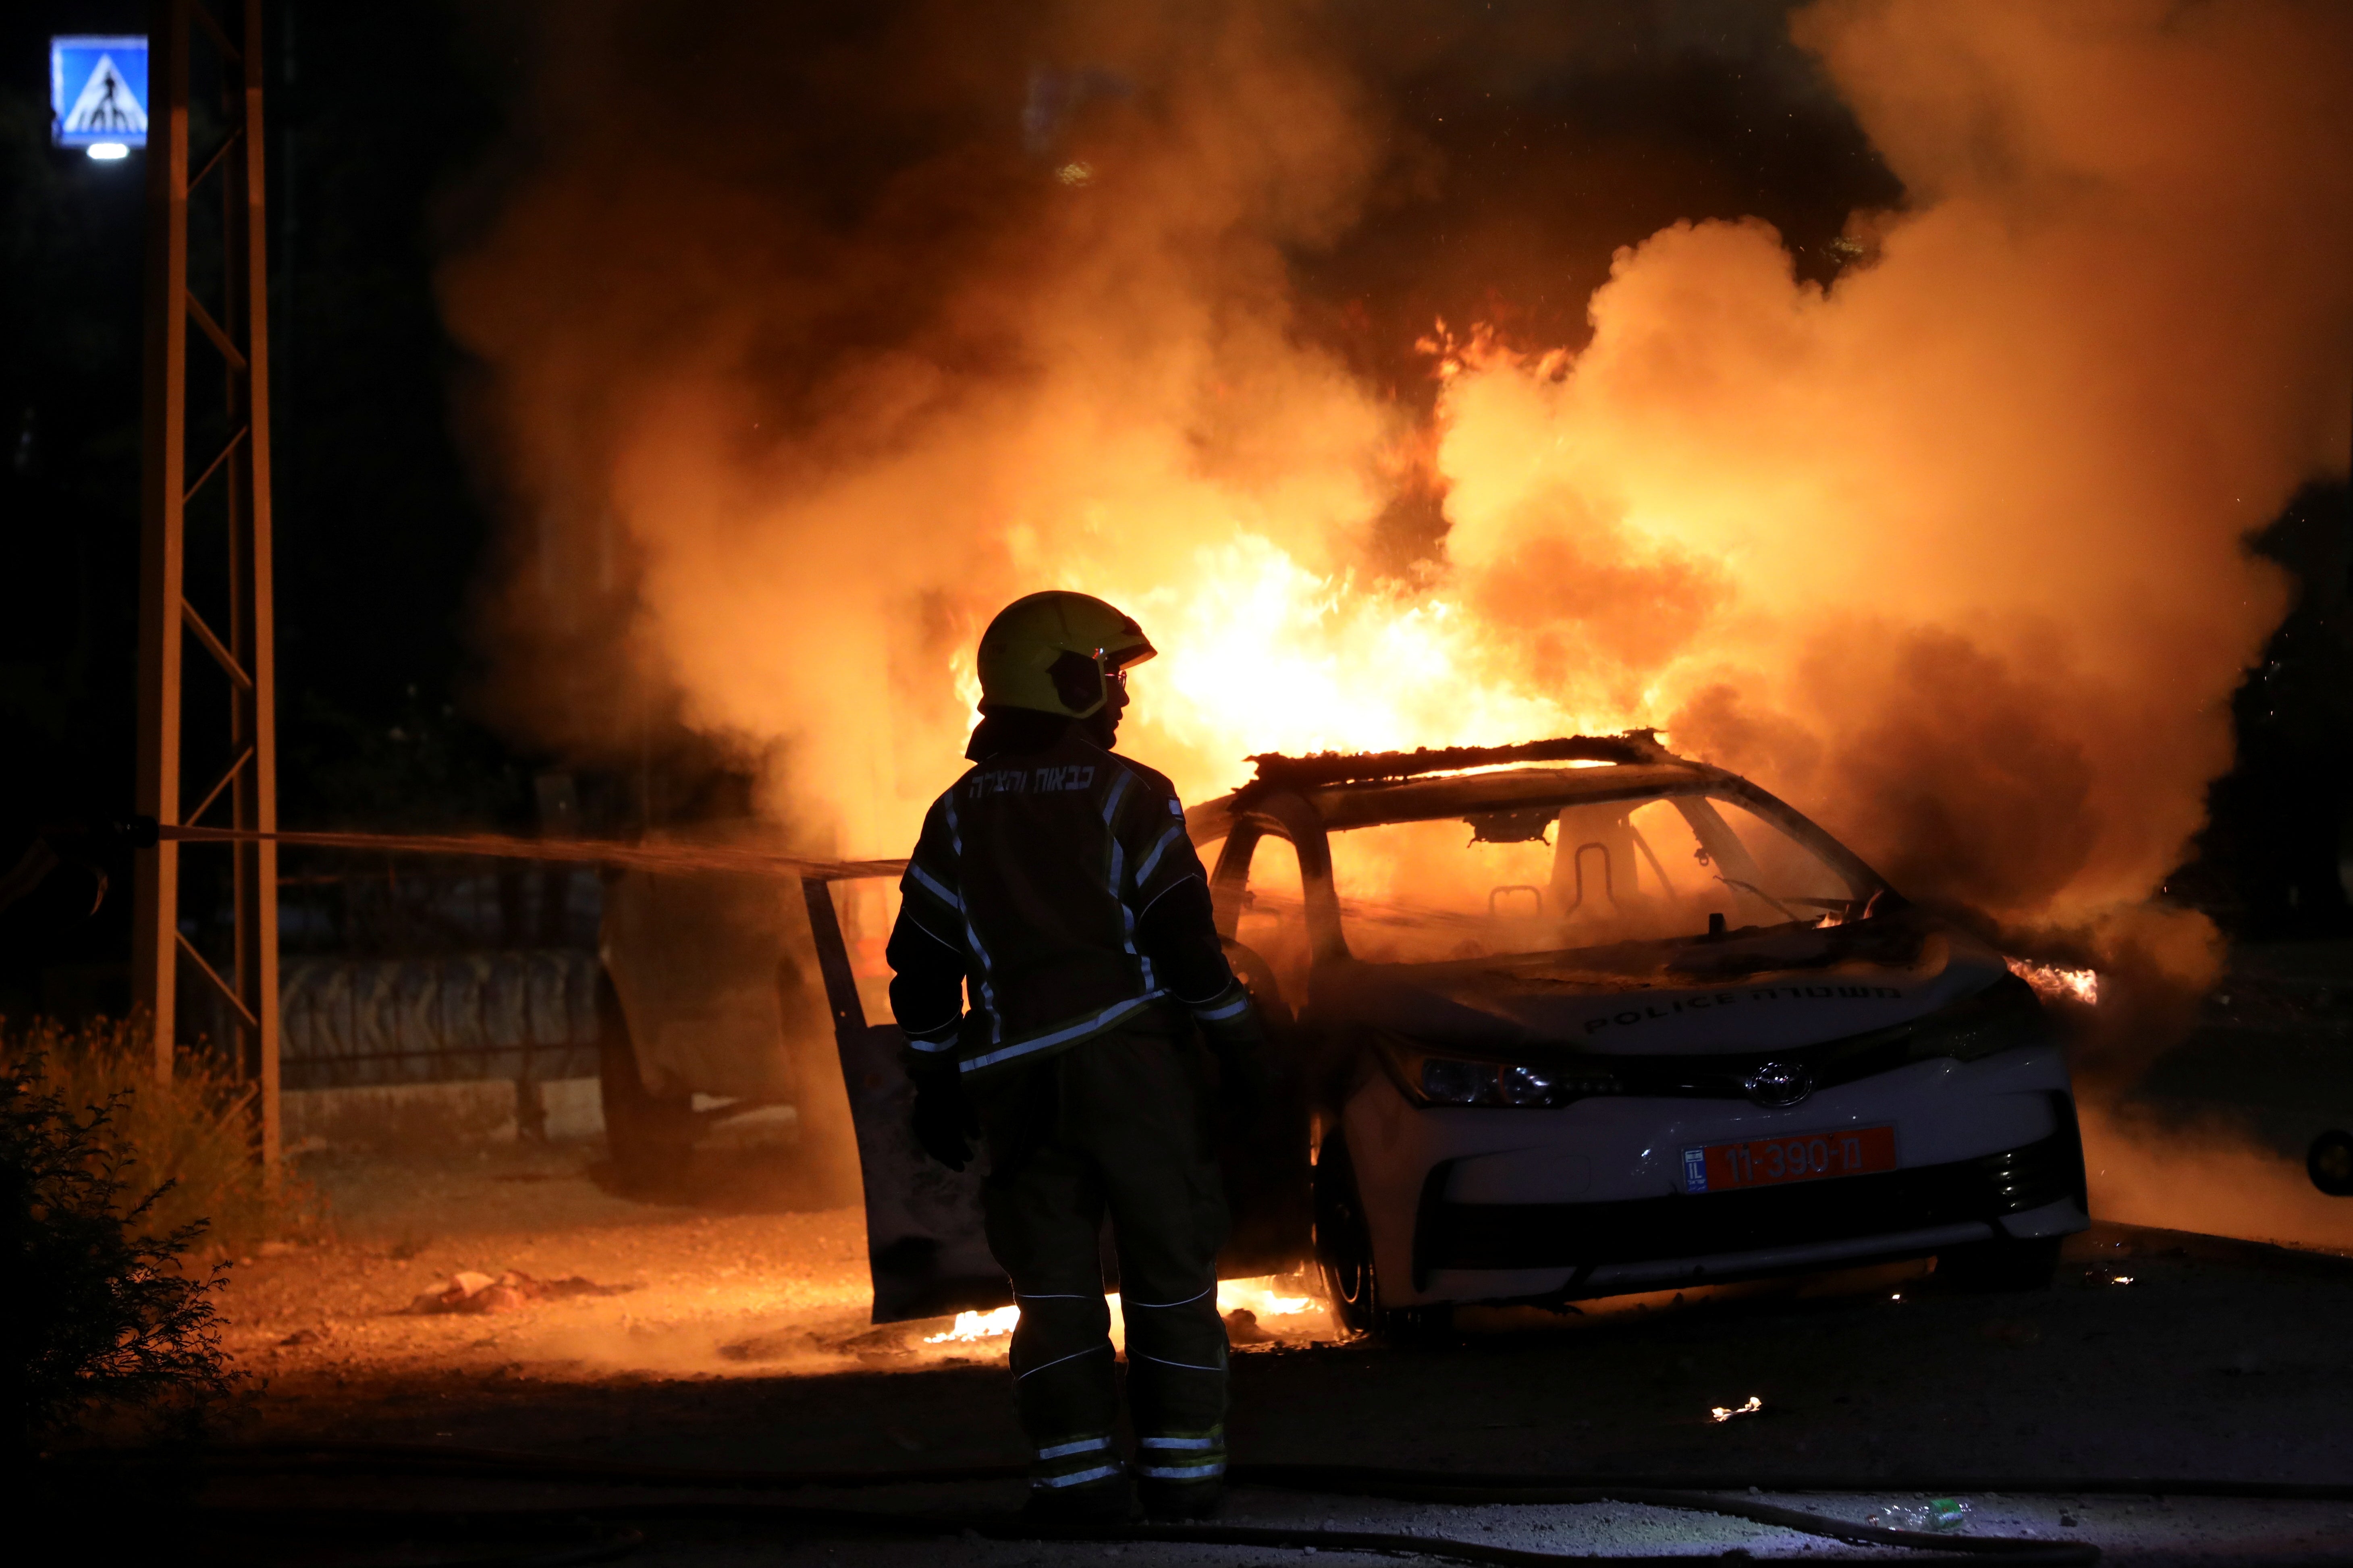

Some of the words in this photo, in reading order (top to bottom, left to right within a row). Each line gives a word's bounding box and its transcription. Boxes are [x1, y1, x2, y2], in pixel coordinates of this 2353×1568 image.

[969, 771, 1028, 798] והצלה
[1033, 766, 1095, 793] כבאות
[1584, 993, 1735, 1034] POLICE
[1750, 987, 1901, 1000] משטרה
[1689, 1163, 1702, 1178] IL
